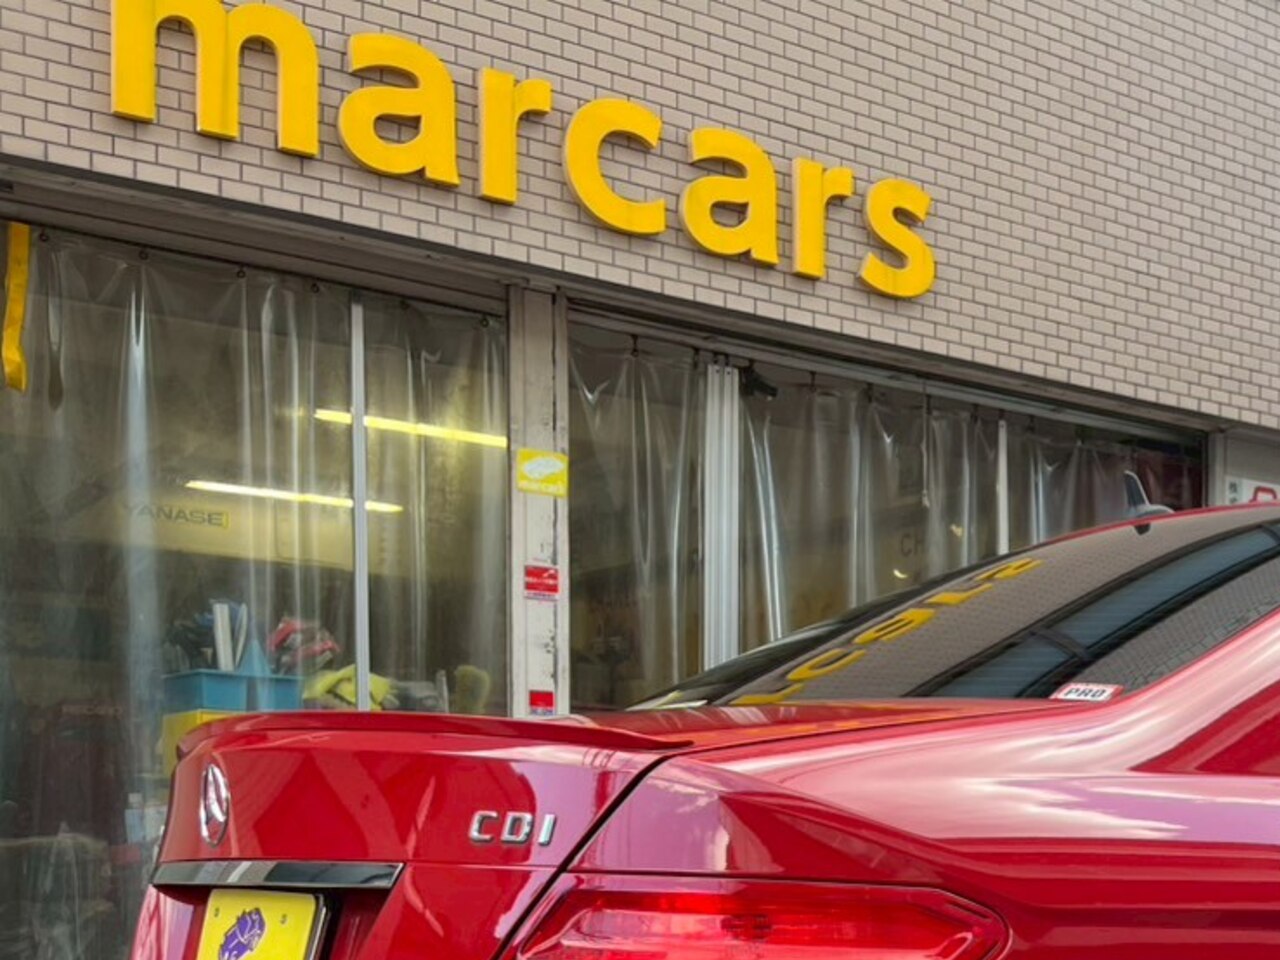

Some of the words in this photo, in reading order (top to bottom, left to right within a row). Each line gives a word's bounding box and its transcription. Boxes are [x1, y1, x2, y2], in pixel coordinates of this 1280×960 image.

[111, 0, 936, 299] marcars
[1063, 687, 1107, 698] PRO
[468, 809, 557, 847] CDI
